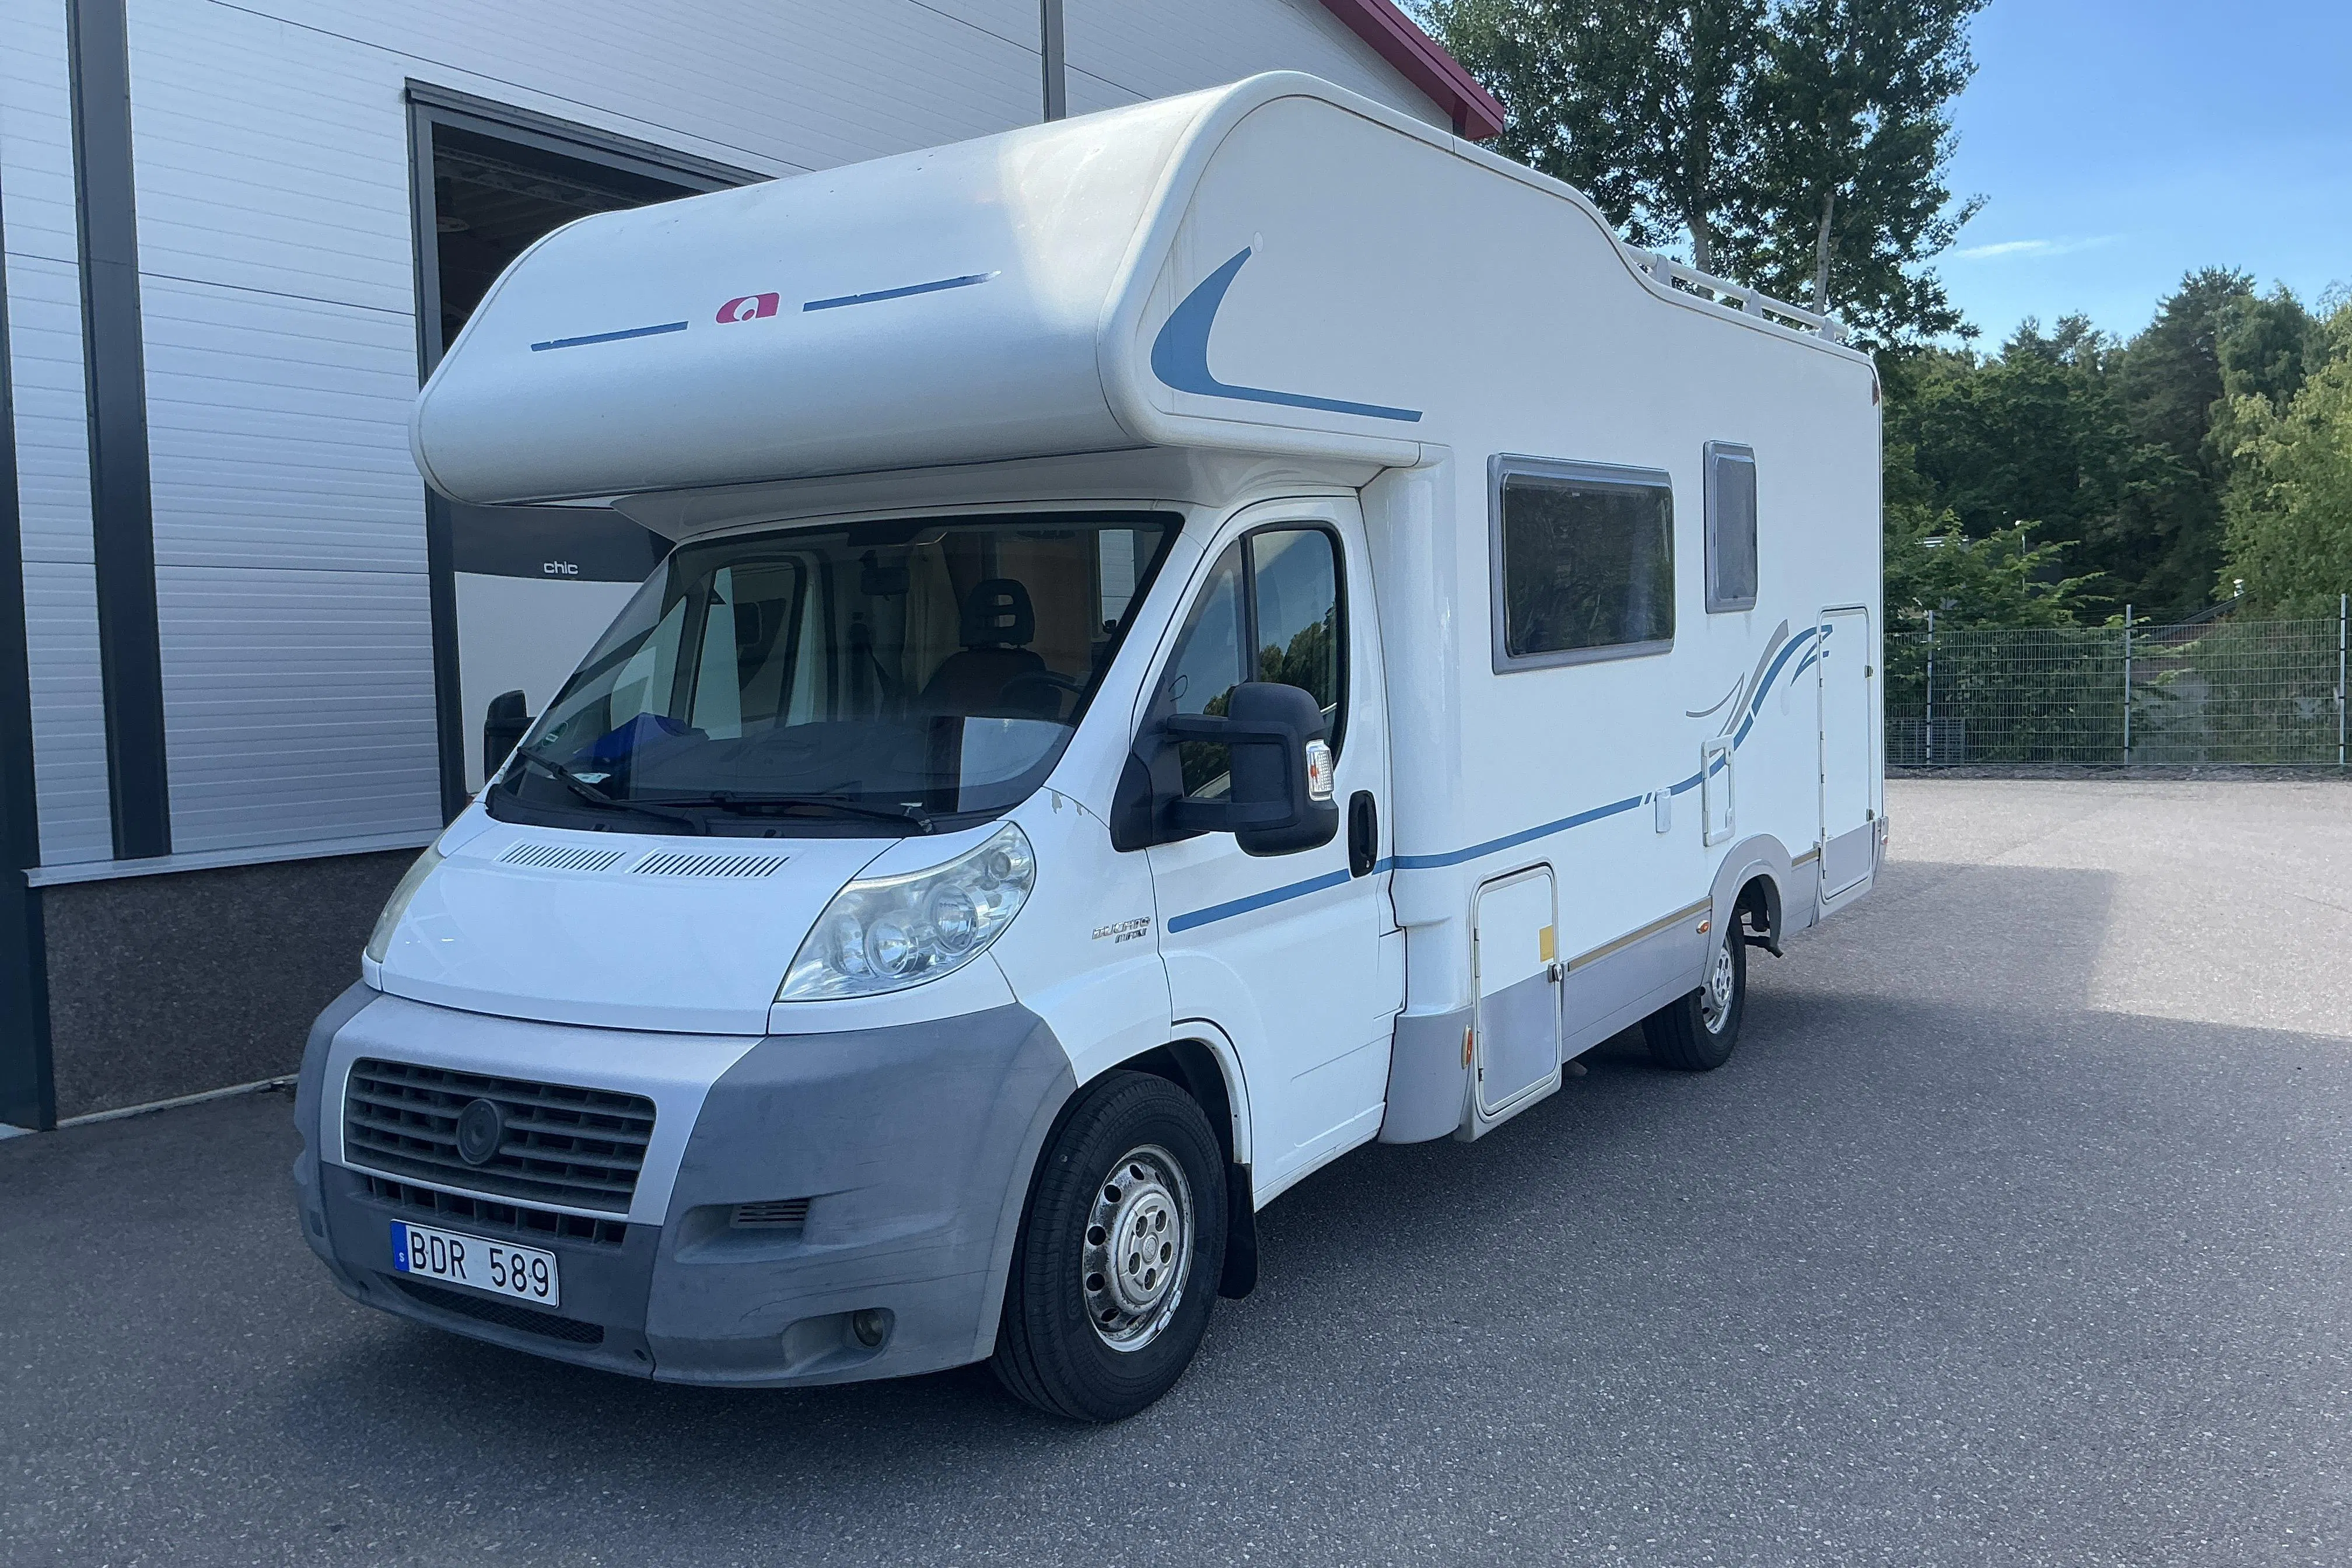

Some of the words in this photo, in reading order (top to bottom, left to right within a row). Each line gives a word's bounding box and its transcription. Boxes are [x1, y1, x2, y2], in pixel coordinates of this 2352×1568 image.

[544, 561, 578, 574] chic
[399, 1252, 405, 1262] S
[410, 1231, 467, 1279] BDR
[489, 1247, 549, 1297] 589
